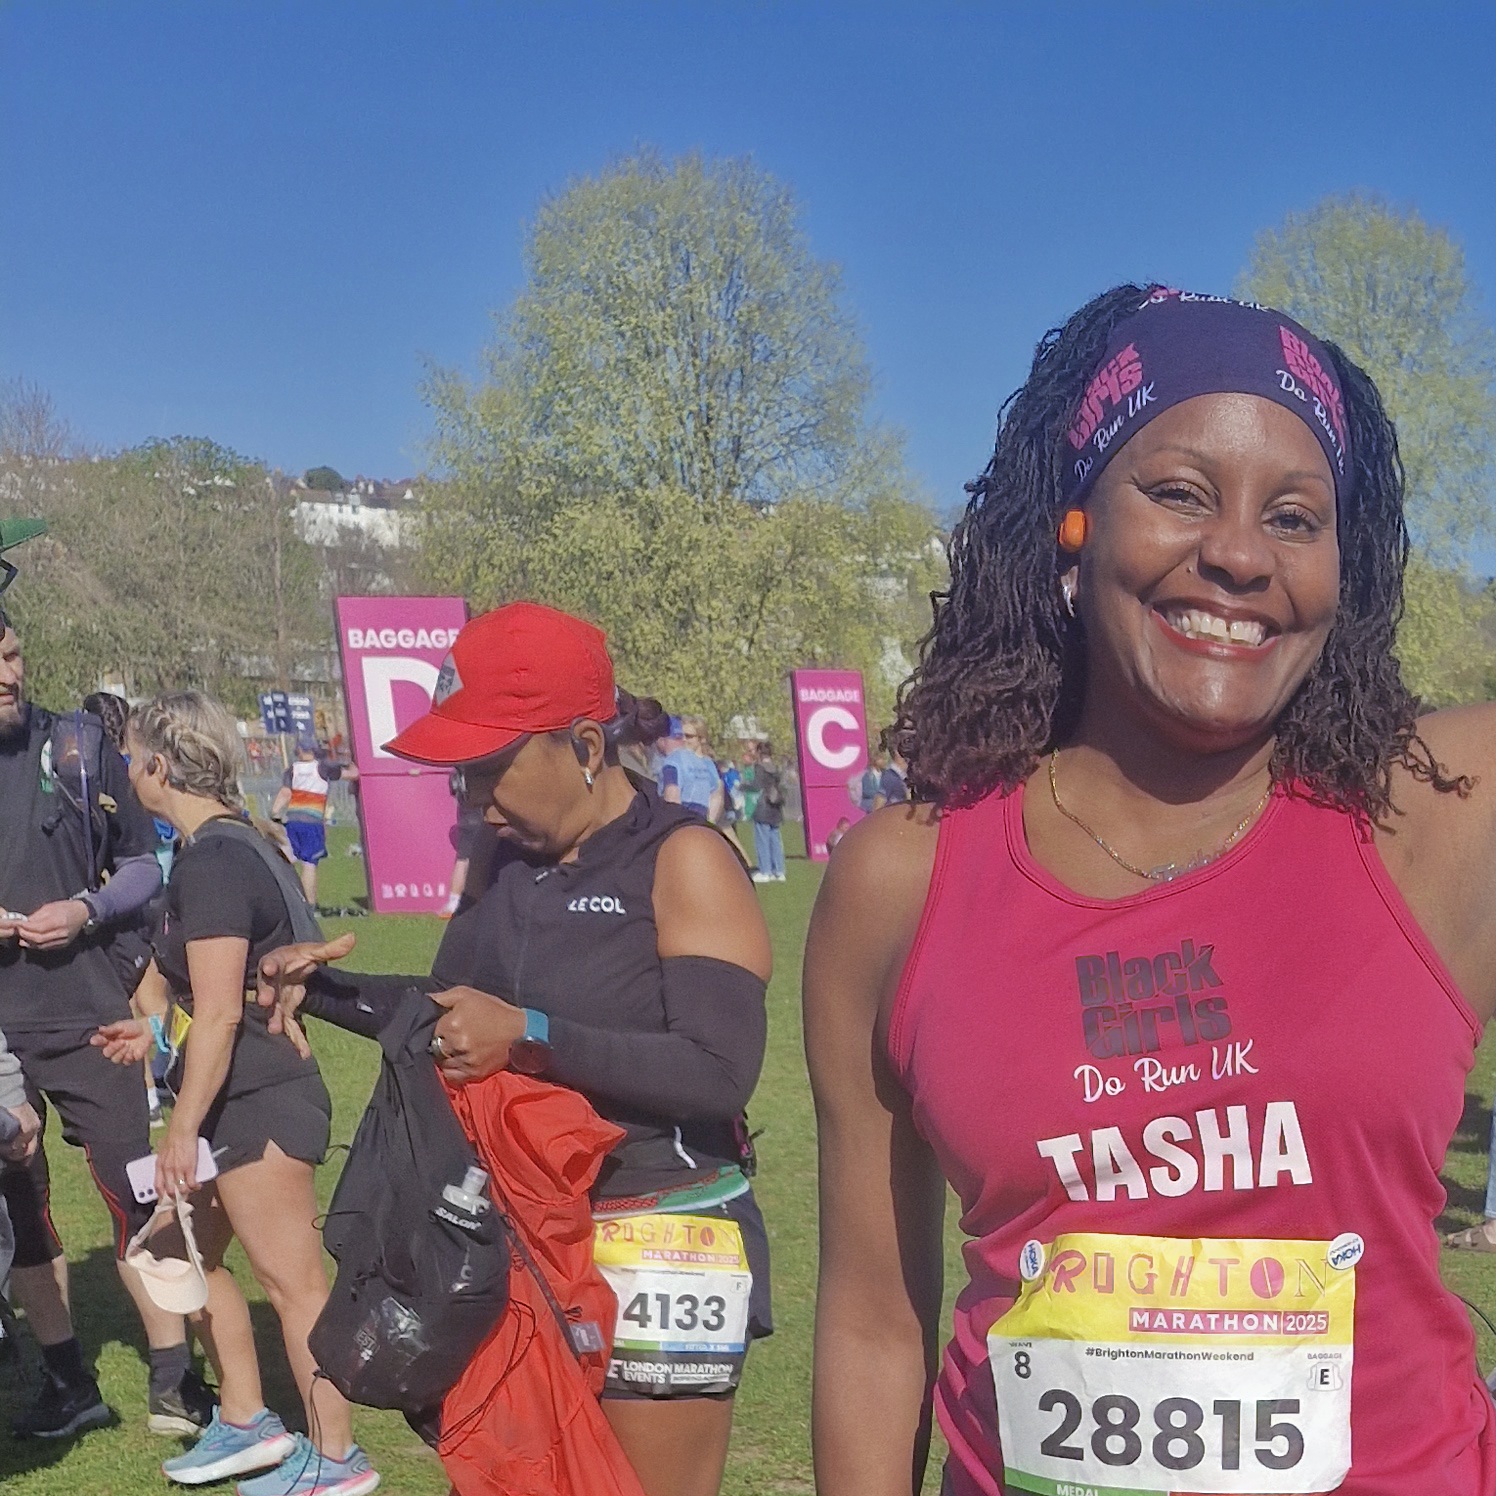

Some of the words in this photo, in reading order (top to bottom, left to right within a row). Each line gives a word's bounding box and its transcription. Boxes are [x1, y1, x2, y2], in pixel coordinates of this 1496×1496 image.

[1276, 369, 1308, 402] Do
[1074, 456, 1094, 483] Do
[1092, 413, 1125, 453] Run
[1127, 381, 1158, 418] UK
[800, 688, 860, 703] BAGGAGE
[807, 706, 860, 770] C
[1075, 938, 1224, 1007] Black
[1081, 997, 1233, 1060] Girls
[1073, 1063, 1126, 1103] Do
[1133, 1056, 1202, 1093] Run
[1211, 1038, 1260, 1081] UK
[1036, 1101, 1313, 1202] TASHA
[602, 1220, 738, 1250] RIGHTON
[642, 1251, 716, 1264] MARATHON
[1049, 1248, 1329, 1300] RIGHTON
[622, 1292, 727, 1332] 4133
[1132, 1310, 1278, 1332] MARATHON
[1285, 1313, 1327, 1332] 2025
[622, 1360, 673, 1375] LONDON
[673, 1362, 734, 1375] MARATHON
[1014, 1350, 1032, 1379] 8
[1085, 1346, 1255, 1362] #BrightonMarathonWeekend
[624, 1371, 666, 1384] EVENTS
[1319, 1368, 1330, 1385] E
[1037, 1388, 1305, 1472] 28815
